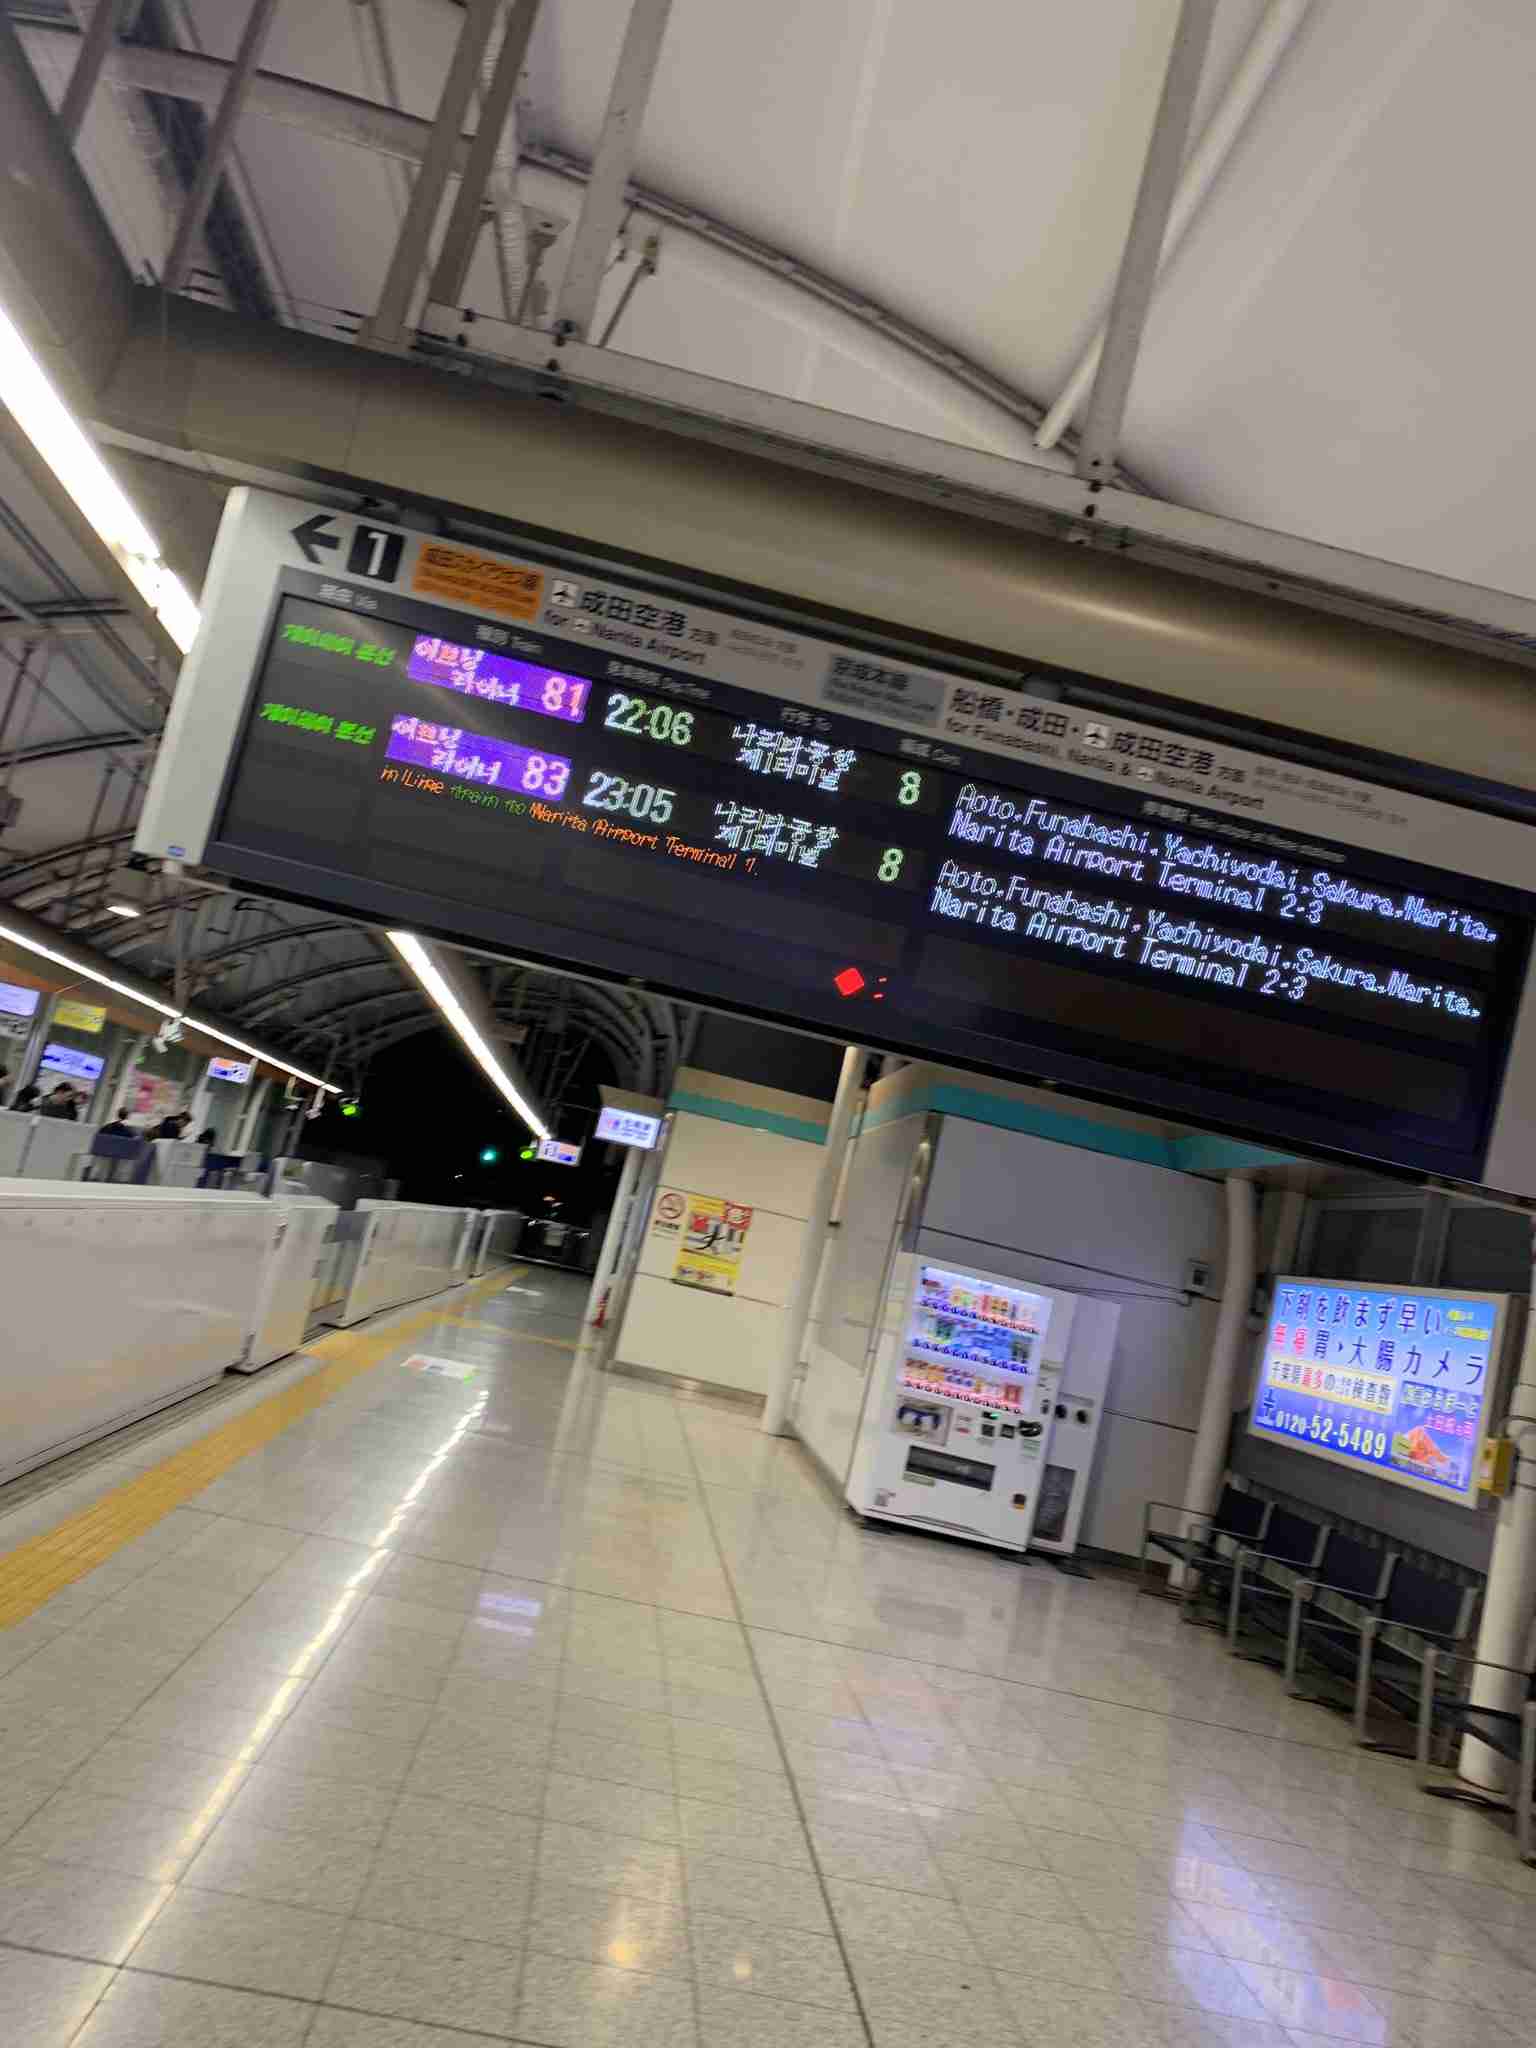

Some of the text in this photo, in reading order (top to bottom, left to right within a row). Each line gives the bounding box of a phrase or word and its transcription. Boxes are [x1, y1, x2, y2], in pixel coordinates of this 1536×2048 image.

[367, 532, 388, 576] 1
[580, 590, 687, 637] 成田空港
[592, 623, 643, 648] Narita
[647, 640, 706, 664] Airport
[541, 676, 586, 717] 81
[604, 693, 694, 745] 22:06
[521, 755, 570, 795] 83
[898, 771, 922, 805] 8
[582, 772, 677, 824] 23:05
[529, 802, 587, 832] Narita
[591, 819, 659, 849] Airport
[666, 835, 737, 870] Terminal
[877, 848, 904, 882] 8
[948, 809, 1033, 855] Narita
[1044, 835, 1144, 881] Airport
[1158, 861, 1264, 912] Terminal
[930, 885, 1016, 931] Narita
[1025, 912, 1126, 959] Airport
[1140, 937, 1249, 988] Terminal
